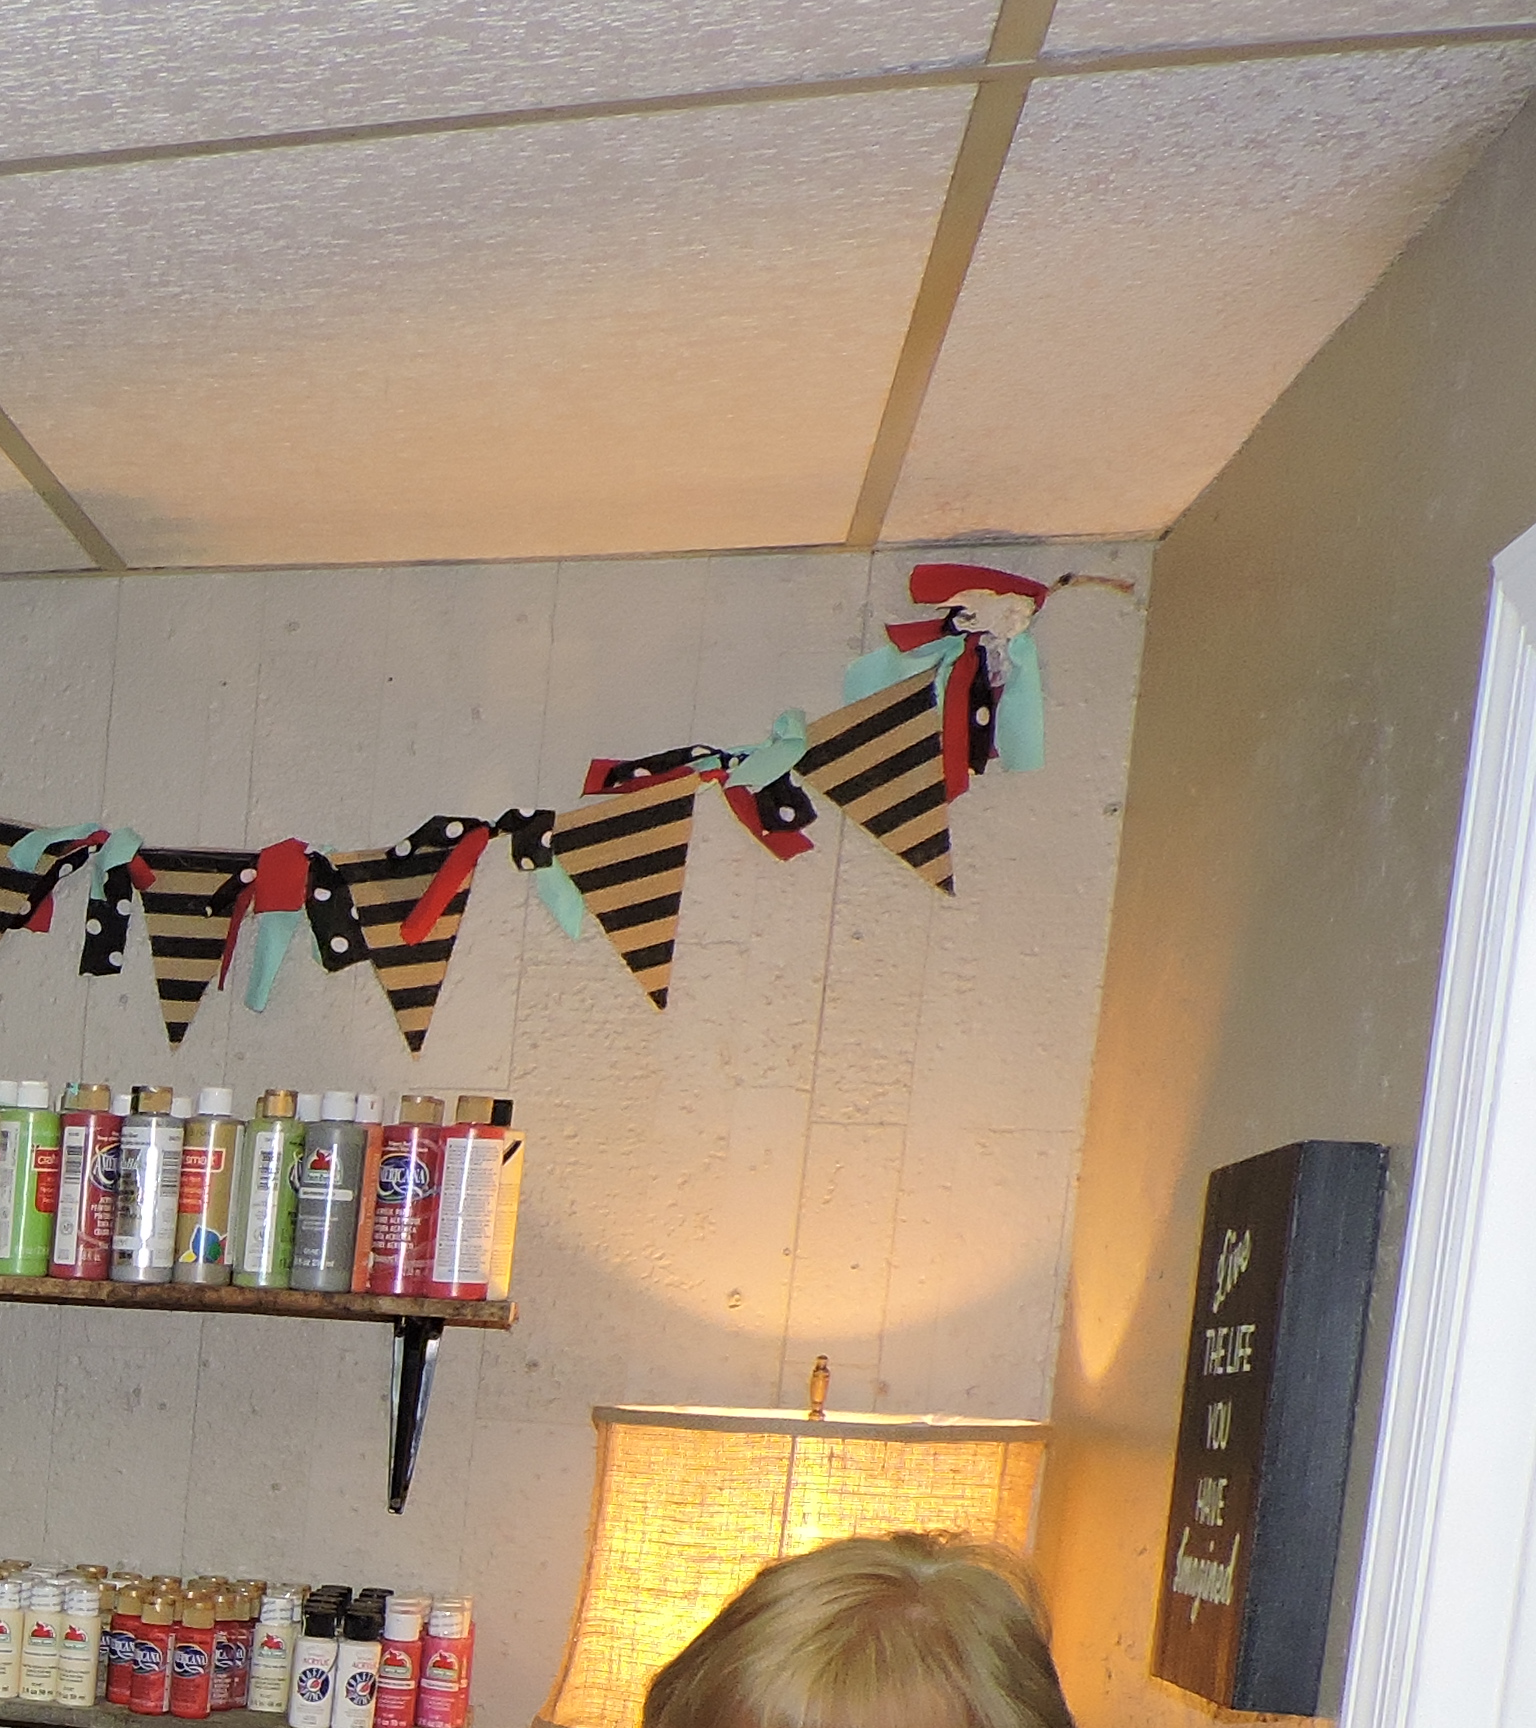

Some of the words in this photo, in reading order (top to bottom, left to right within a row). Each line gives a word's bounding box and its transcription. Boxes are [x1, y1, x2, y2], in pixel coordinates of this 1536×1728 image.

[1204, 1327, 1228, 1375] THE
[1226, 1325, 1256, 1374] LIFE
[1206, 1401, 1232, 1450] YOU
[1195, 1478, 1228, 1527] HAVE
